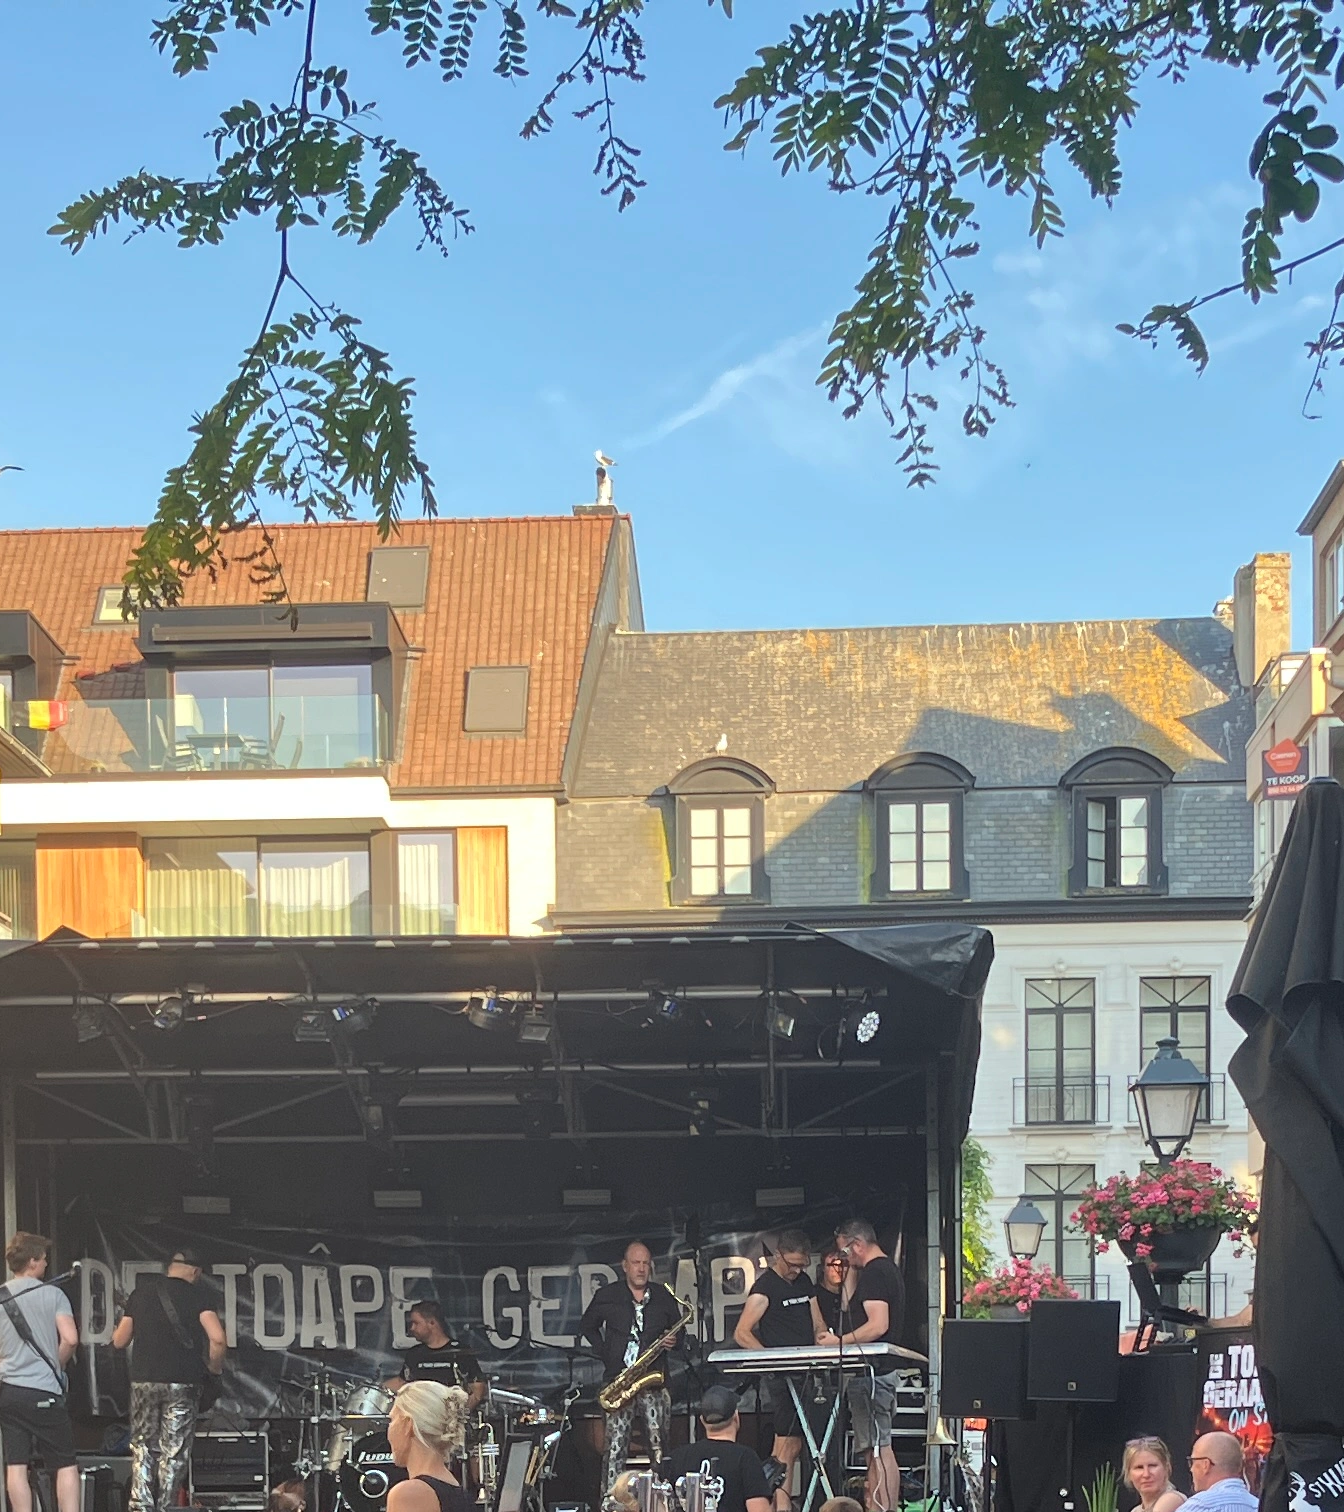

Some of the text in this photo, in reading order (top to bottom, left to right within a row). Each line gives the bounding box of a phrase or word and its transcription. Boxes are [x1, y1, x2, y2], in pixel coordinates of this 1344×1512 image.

[1279, 775, 1305, 785] KOOP
[1228, 1345, 1258, 1378] TO
[1229, 1409, 1248, 1433] ON
